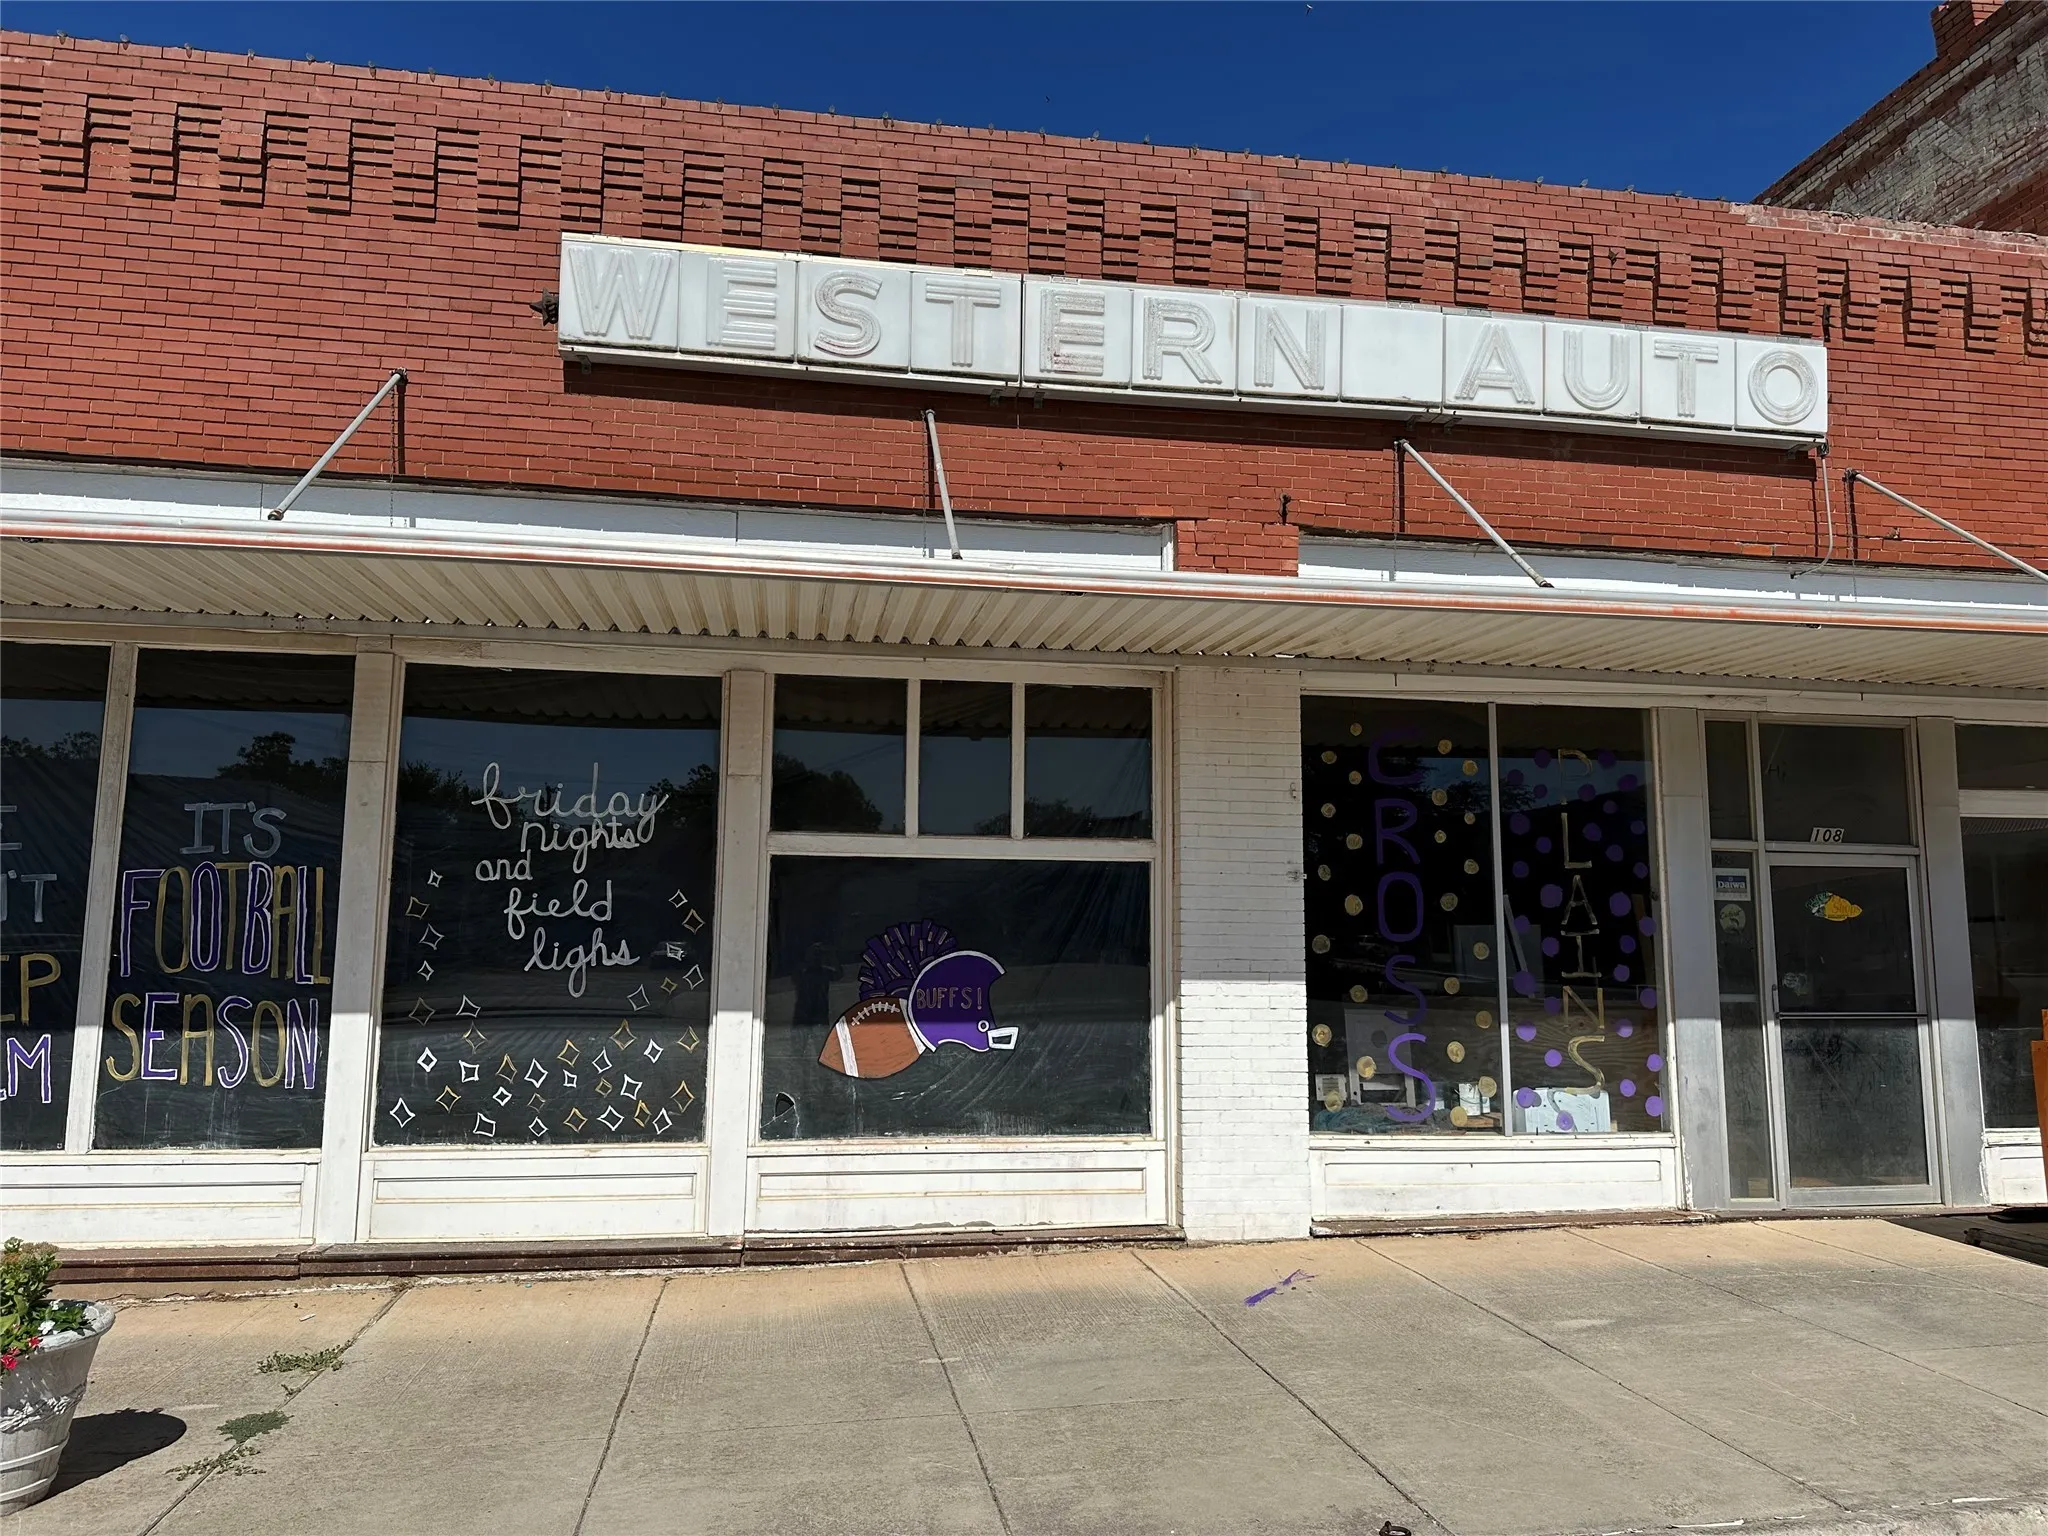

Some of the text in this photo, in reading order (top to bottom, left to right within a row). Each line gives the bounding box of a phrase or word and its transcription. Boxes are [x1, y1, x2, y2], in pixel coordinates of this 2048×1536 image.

[568, 246, 1819, 426] WESTERN AUTO
[179, 800, 287, 858] IT'S
[471, 762, 669, 843] friday
[475, 850, 533, 881] and
[1813, 828, 1843, 842] 108
[0, 869, 58, 923] 'T
[503, 879, 613, 940] field
[1717, 880, 1746, 889] Daiwa
[119, 860, 332, 985] FOOTBALL
[1368, 728, 1437, 1123] CROSS
[523, 926, 641, 998] lighs
[916, 986, 983, 1010] BUFFS!
[105, 992, 319, 1090] SEASON
